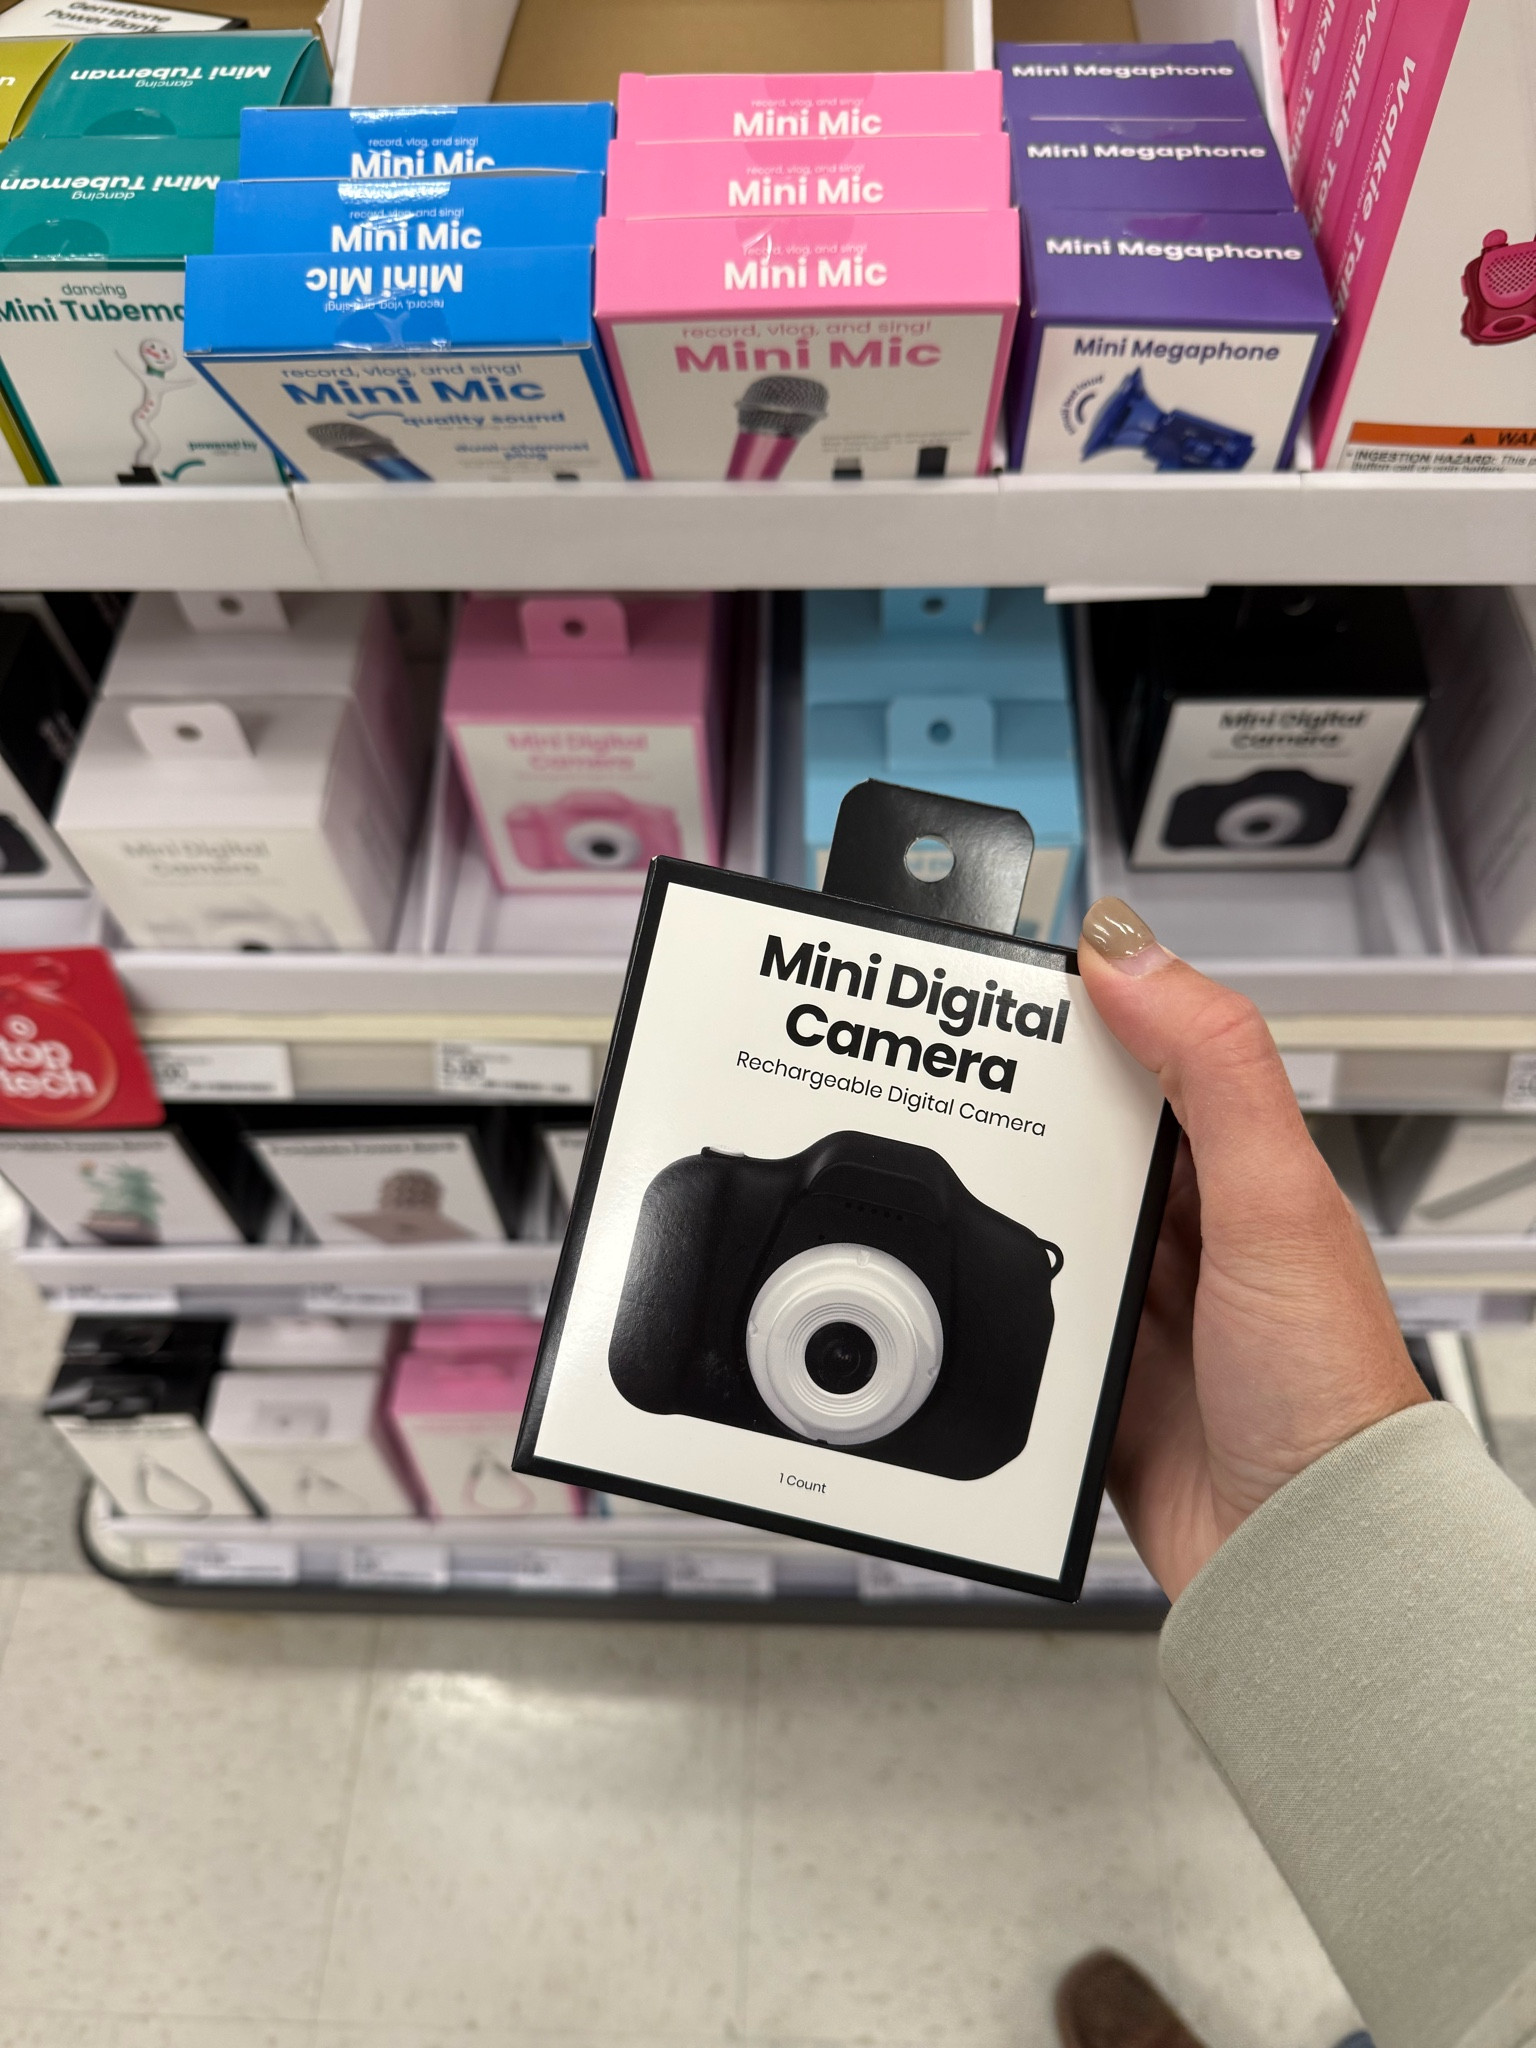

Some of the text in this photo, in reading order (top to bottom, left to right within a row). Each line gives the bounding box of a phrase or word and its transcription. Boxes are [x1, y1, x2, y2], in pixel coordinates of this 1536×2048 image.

[45, 9, 109, 25] Power
[107, 19, 162, 33] Bank
[68, 1, 172, 23] Gemstone
[70, 65, 272, 81] Mini Tubeman
[1011, 63, 1235, 79] Mini Megaphone
[134, 80, 194, 89] dancing
[731, 107, 884, 138] Mini Mic
[368, 136, 480, 149] record, vlog, and sing!
[1361, 55, 1417, 222] Walkie
[350, 148, 496, 178] Mini Mic
[1026, 144, 1267, 161] Mini Megaphone
[814, 163, 837, 175] and
[0, 175, 221, 191] Mini Tubeman
[727, 175, 885, 208] Mini Mic
[71, 190, 136, 201] dancing
[438, 205, 465, 219] sing!
[331, 219, 483, 253] Mini Mic
[813, 242, 838, 255] and
[1045, 238, 1303, 263] Mini Megaphone
[305, 263, 464, 300] Mini Mic
[723, 256, 888, 291] Mini Mic
[61, 282, 128, 300] dancing
[0, 298, 186, 323] Mini Tubema
[681, 319, 932, 340] record, vlog, and sing!
[674, 336, 943, 374] Mini Mic
[1073, 336, 1280, 364] Mini Megaphone
[281, 361, 523, 381] record, vlog, and sing!
[281, 377, 547, 407] Mini Mic
[1354, 449, 1431, 463] INGESTION
[758, 934, 1072, 1045] Mini Digital
[784, 1002, 1019, 1094] Camera
[735, 1050, 1047, 1137] Rechargeable Digital Camera
[779, 1472, 827, 1494] 1 Count
